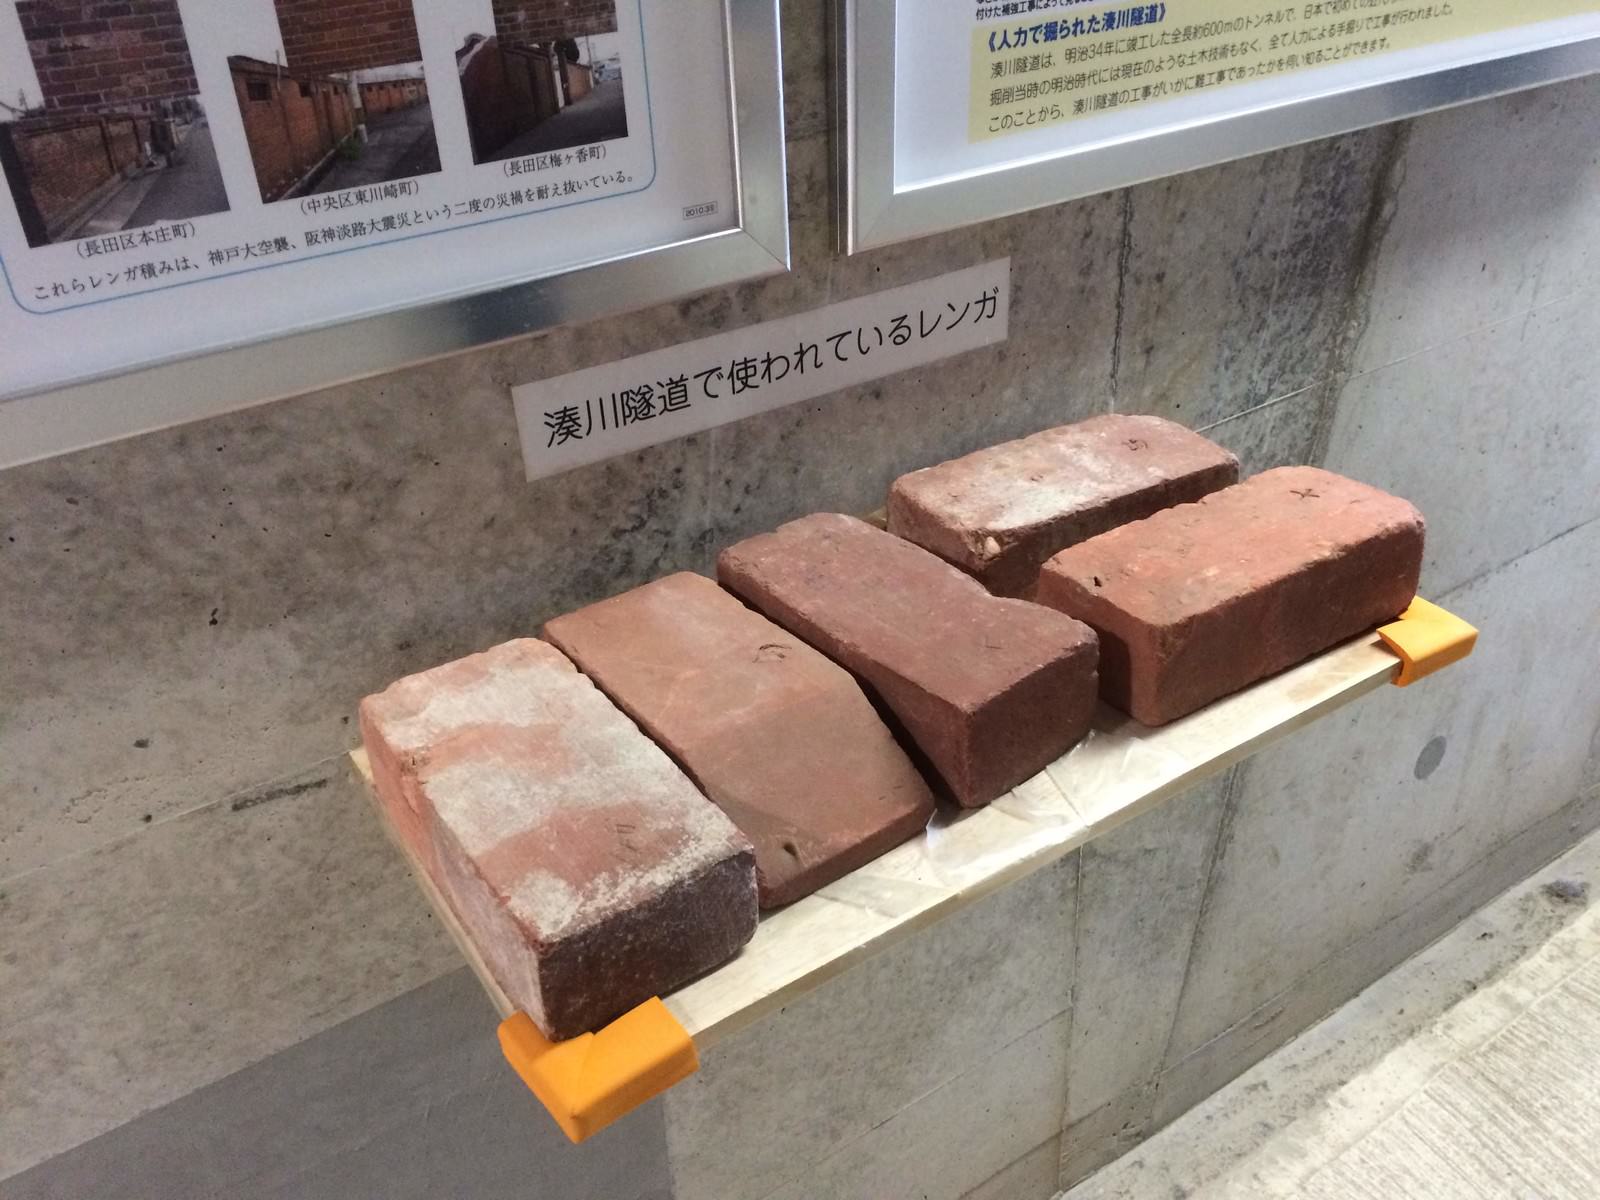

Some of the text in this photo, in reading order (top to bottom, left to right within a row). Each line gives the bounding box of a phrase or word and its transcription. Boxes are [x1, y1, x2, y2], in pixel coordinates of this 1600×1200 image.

[77, 222, 198, 258] （長田区本庄町）
[544, 286, 1000, 448] 湊川隧道で使われているレンガ
